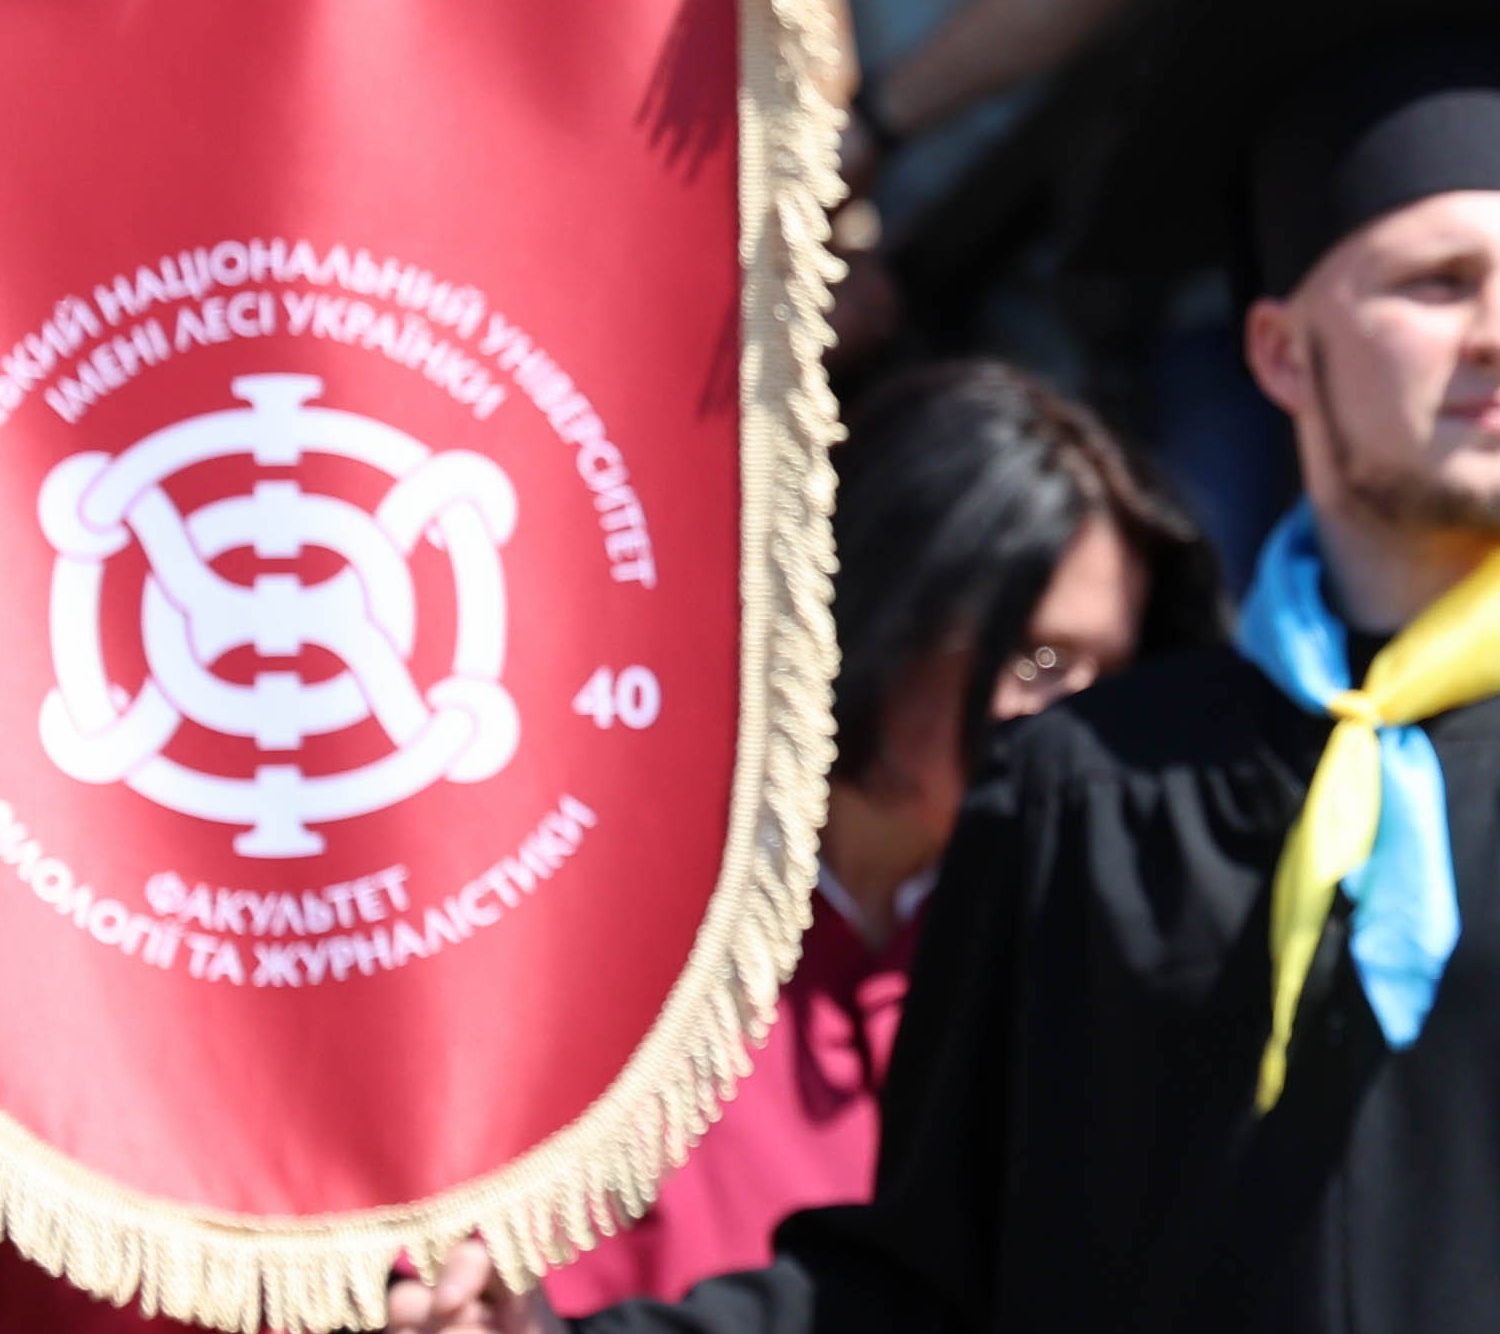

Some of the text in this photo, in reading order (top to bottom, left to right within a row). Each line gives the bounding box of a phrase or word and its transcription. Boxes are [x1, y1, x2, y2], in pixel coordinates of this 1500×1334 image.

[44, 289, 506, 424] ІМЕНІ ЛЕСІ УКРАЇНКИ
[94, 236, 486, 339] НАЦІОНАЛЬНИЙ
[479, 312, 657, 590] УНІВЕРСИТЕТ
[572, 664, 663, 731] 40
[145, 862, 410, 937] ФАКУЛЬТЕТ
[185, 931, 245, 986] ТА
[252, 792, 599, 988] ЖУРНАЛІСТИКИ
